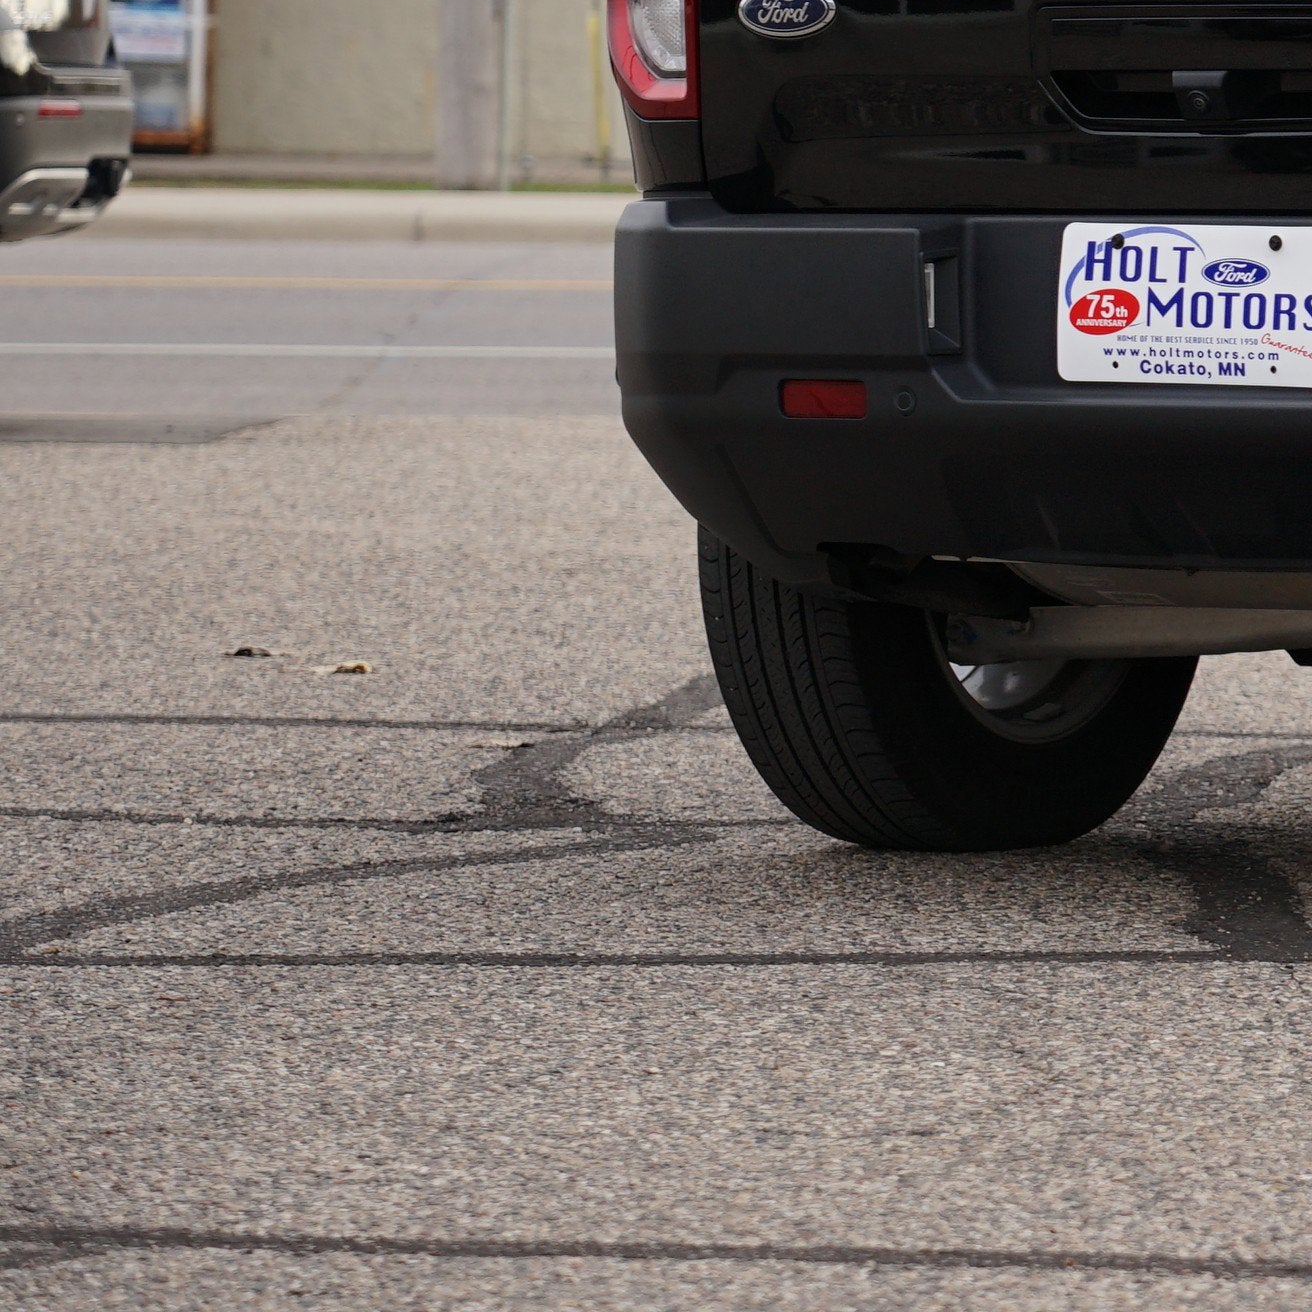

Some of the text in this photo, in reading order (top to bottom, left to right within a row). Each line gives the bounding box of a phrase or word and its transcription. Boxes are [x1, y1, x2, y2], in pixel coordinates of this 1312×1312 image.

[1084, 240, 1196, 284] HOLT
[1085, 294, 1129, 319] 75th
[1075, 318, 1127, 328] ANNIVERSARY
[1140, 335, 1149, 343] OF
[1151, 335, 1165, 343] THE
[1166, 336, 1183, 344] BEST
[1216, 337, 1238, 345] SINCE
[1240, 338, 1259, 346] 1950
[1103, 347, 1280, 361] www.holtmotors.com
[1140, 359, 1247, 378] Cokato, MN
